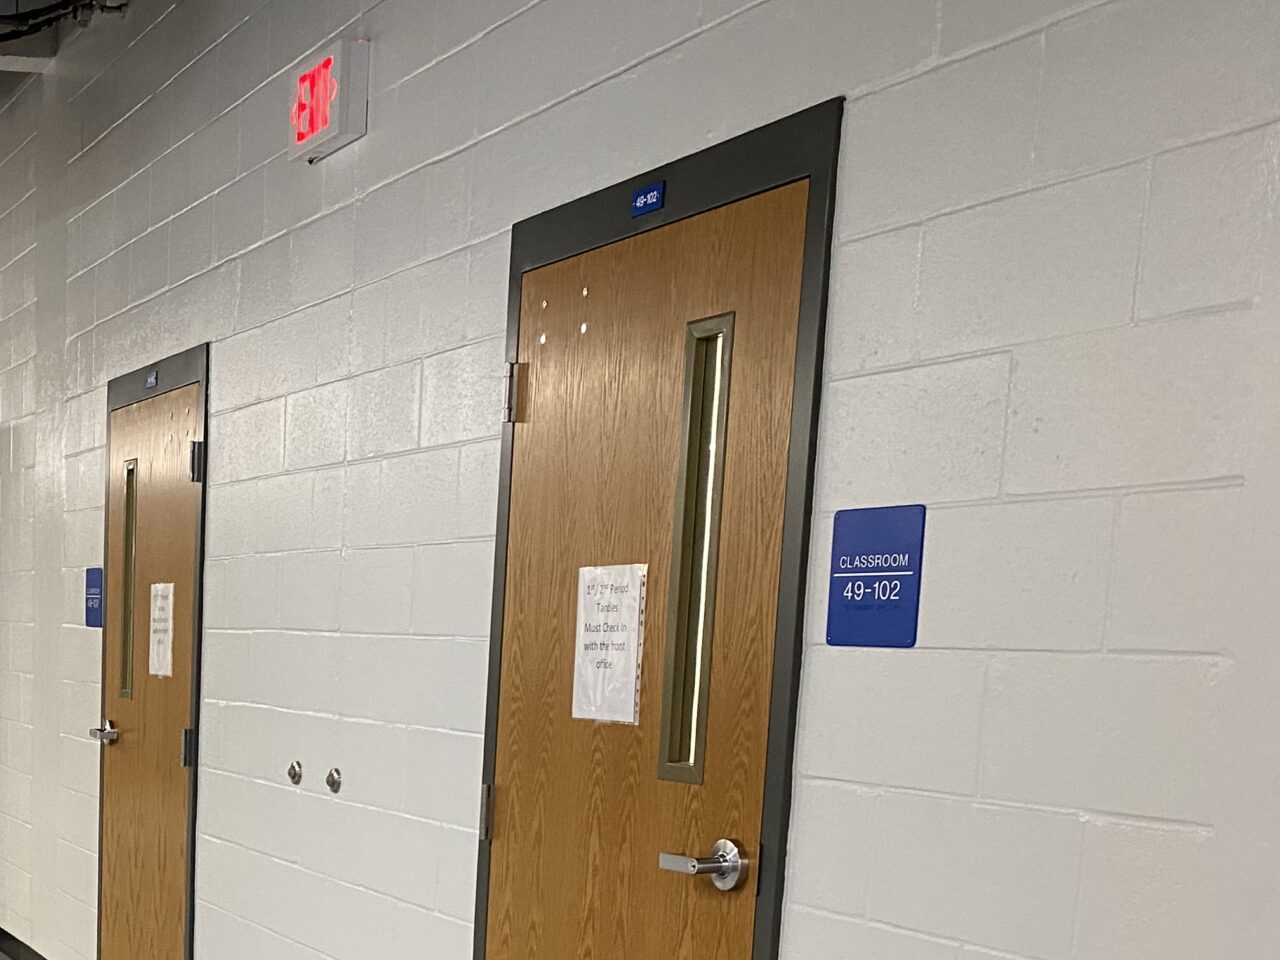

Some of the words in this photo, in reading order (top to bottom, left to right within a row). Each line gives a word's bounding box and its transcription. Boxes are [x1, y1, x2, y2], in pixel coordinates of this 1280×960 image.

[296, 55, 334, 144] EXIT
[636, 191, 657, 207] 49-102
[840, 553, 909, 568] CLASSROOM
[610, 582, 629, 594] Period
[843, 580, 901, 600] 49-102
[596, 602, 619, 612] Tardies
[584, 623, 601, 632] Must
[602, 622, 619, 632] Check
[584, 641, 599, 651] with
[600, 641, 609, 651] the
[611, 640, 626, 651] front
[596, 658, 613, 669] office
